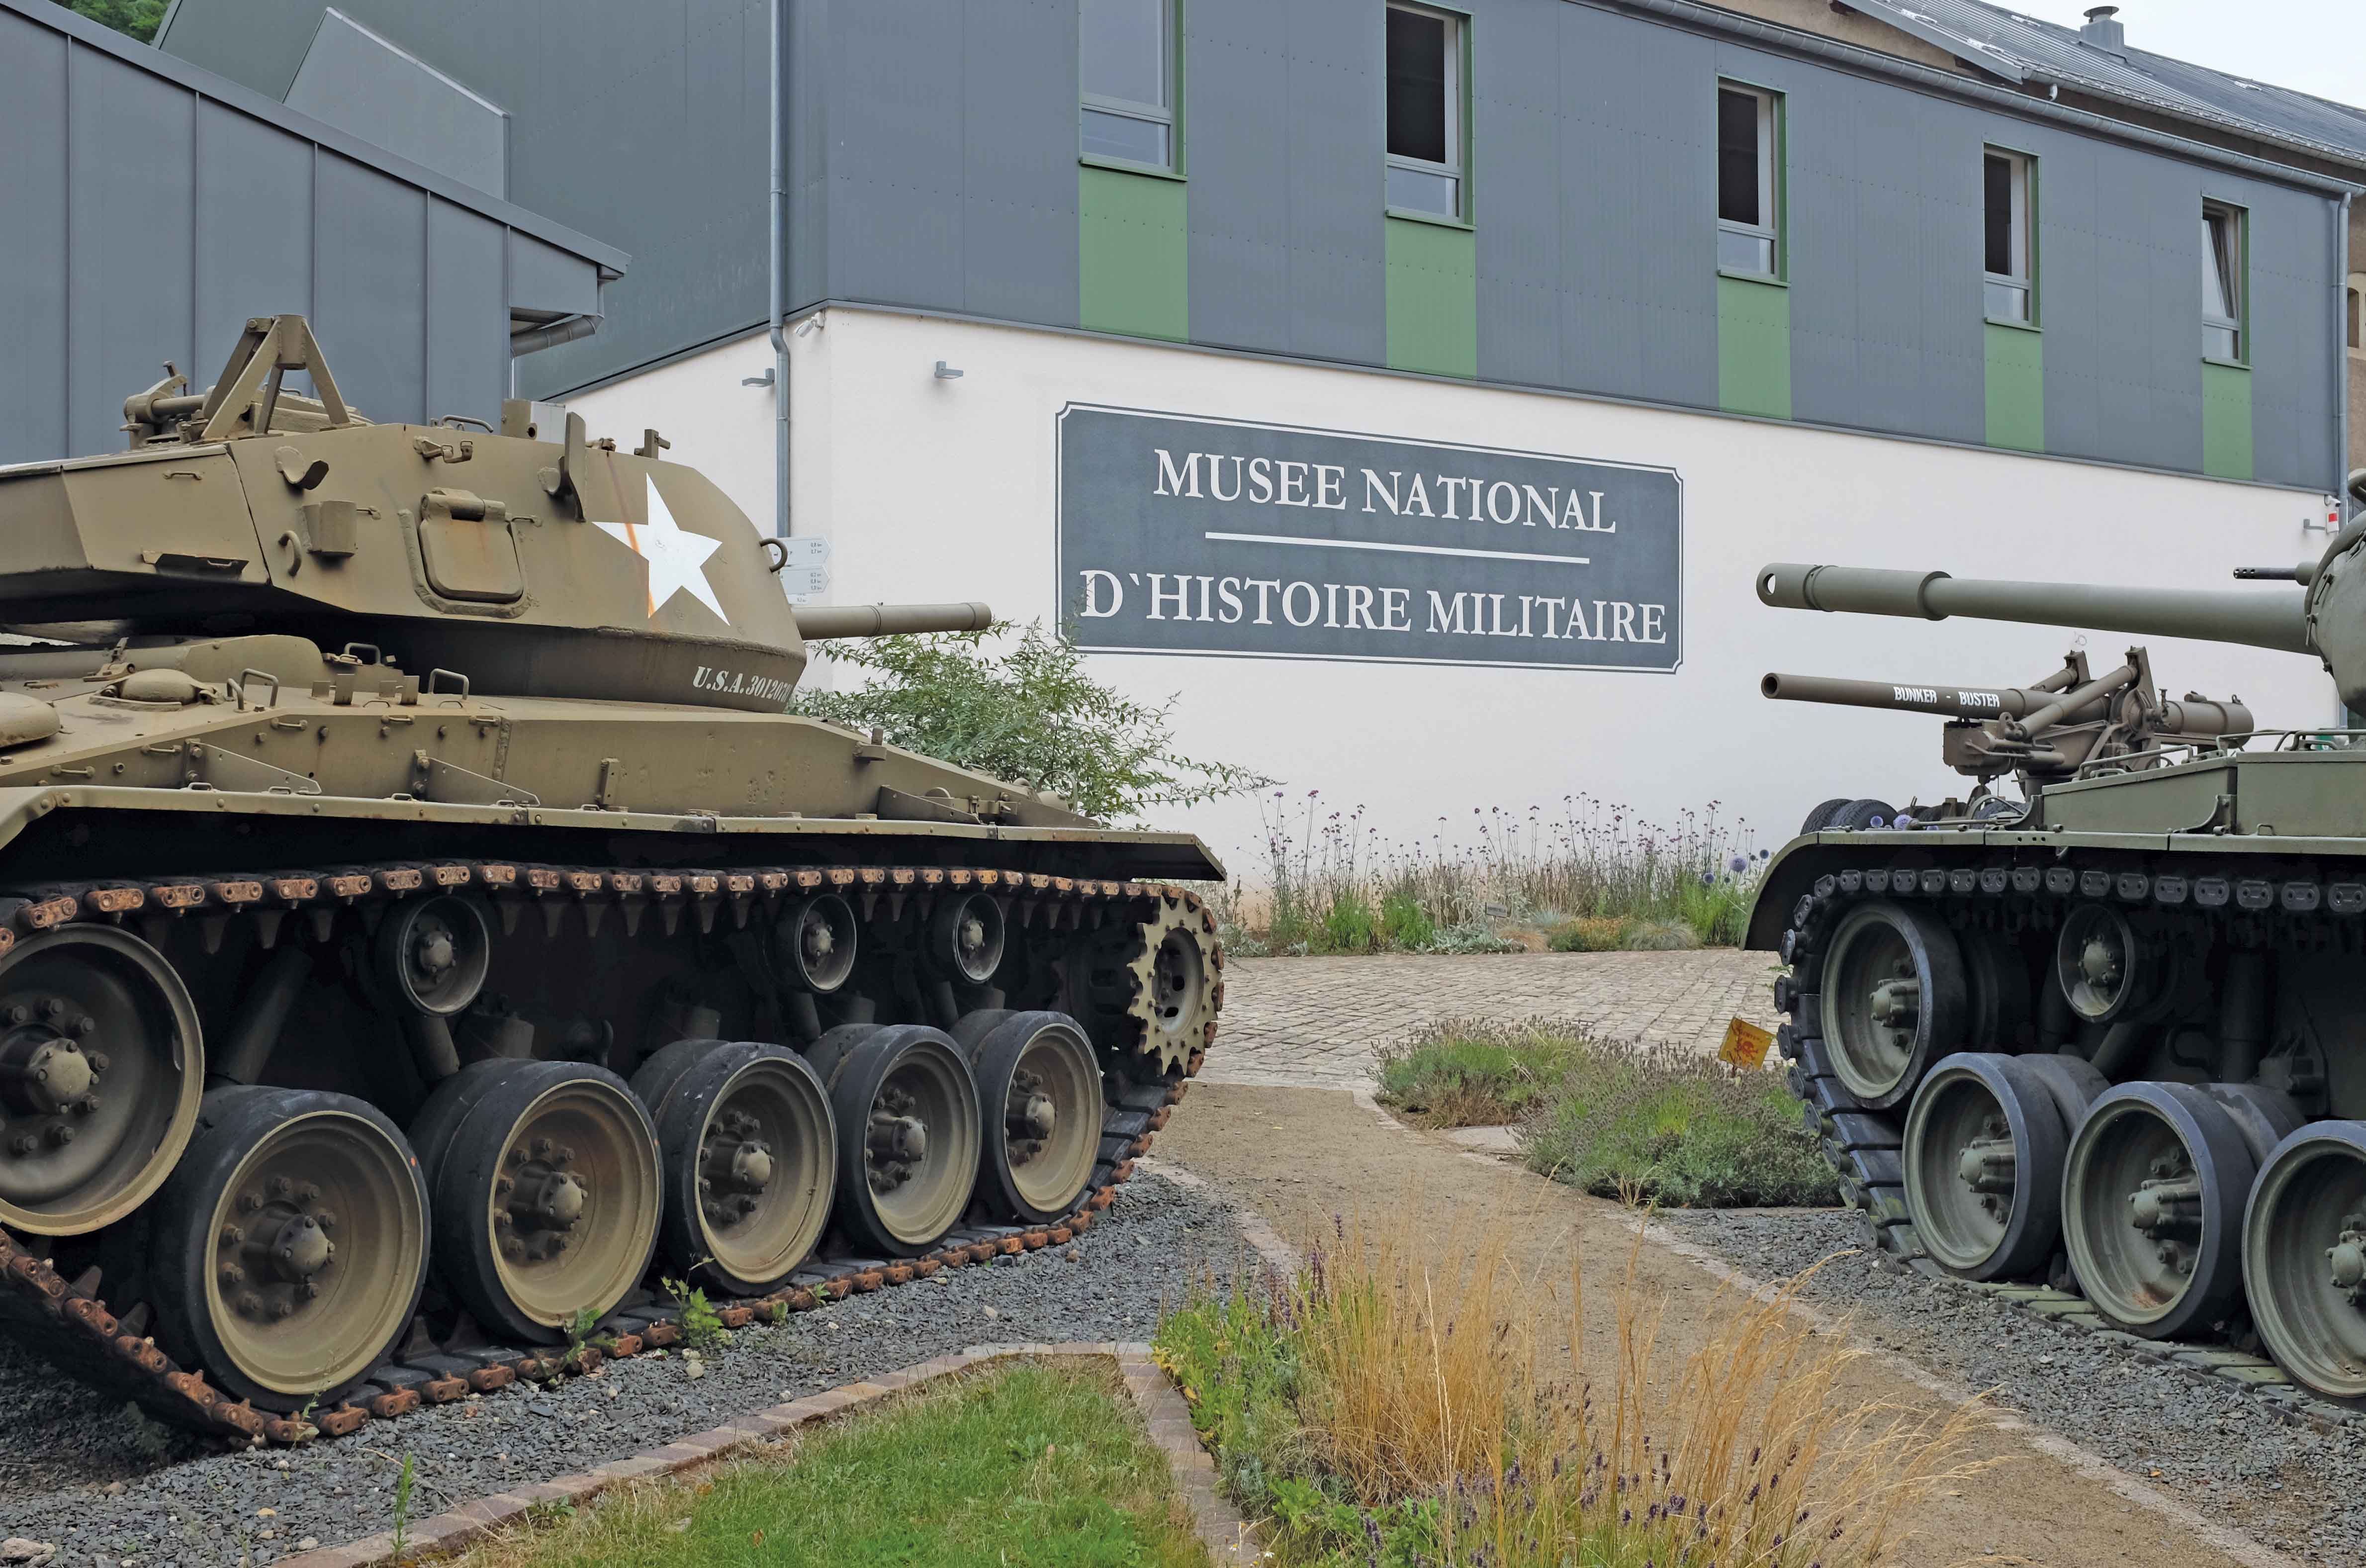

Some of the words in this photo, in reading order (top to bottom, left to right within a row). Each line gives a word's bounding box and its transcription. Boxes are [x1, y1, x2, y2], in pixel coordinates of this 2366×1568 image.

[1153, 449, 1347, 510] MUSEE
[1360, 468, 1616, 534] NATIONAL
[1426, 590, 1667, 645] MILITAIRE
[1893, 686, 1938, 704] BUNKER
[1957, 691, 2001, 708] BUSTER
